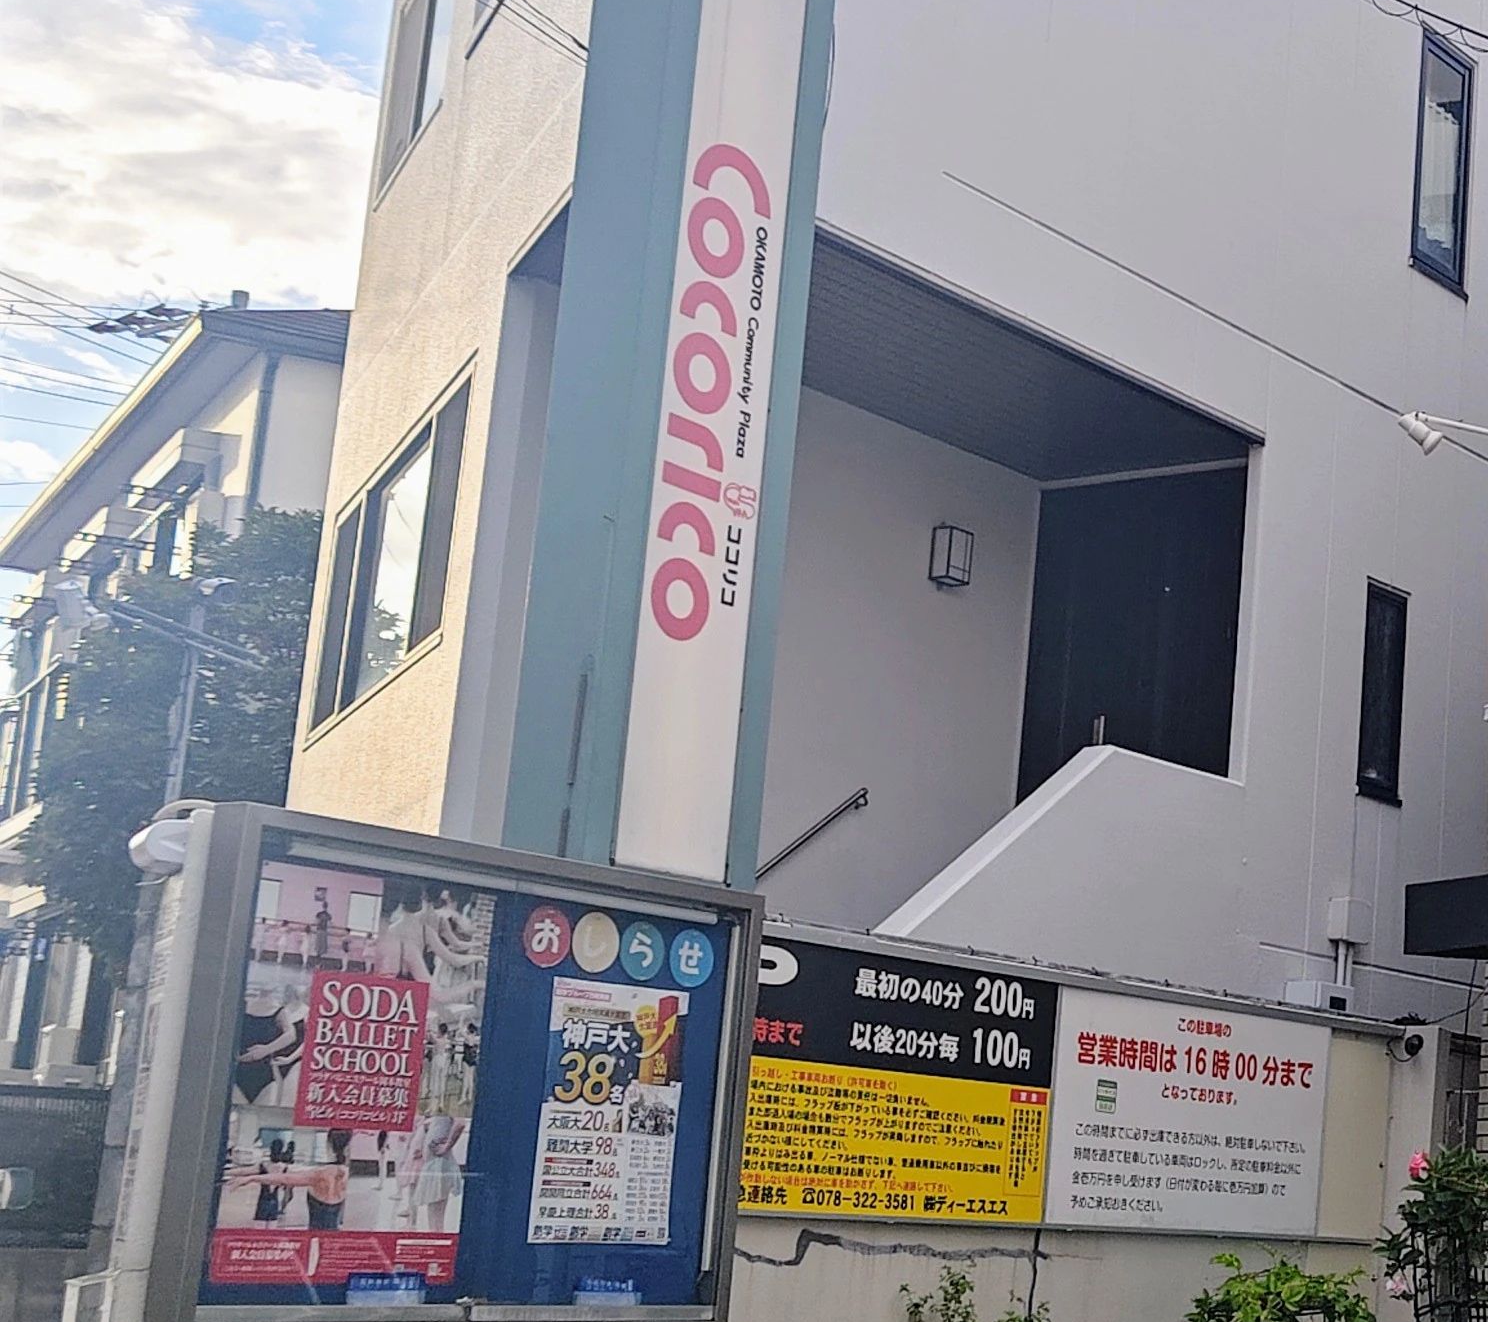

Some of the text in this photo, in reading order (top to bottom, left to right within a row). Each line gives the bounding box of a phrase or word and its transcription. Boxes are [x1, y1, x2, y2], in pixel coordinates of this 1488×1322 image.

[735, 226, 768, 459] OKAMOTO Community Plaza
[720, 524, 743, 608] ココリコ
[318, 980, 419, 1024] SODA
[853, 967, 1035, 1020] 最初の40分 200円
[313, 1017, 419, 1052] BALLET
[561, 1018, 632, 1054] 神戸大
[849, 1022, 1031, 1070] 以後20分毎 100円
[1177, 1017, 1232, 1038] この駐車場の
[310, 1046, 414, 1077] SCHOOL
[1077, 1030, 1314, 1089] 営業時間は 16 時 00 分まで
[305, 1081, 409, 1109] 新入会員募集
[1161, 1083, 1238, 1106] となっております。
